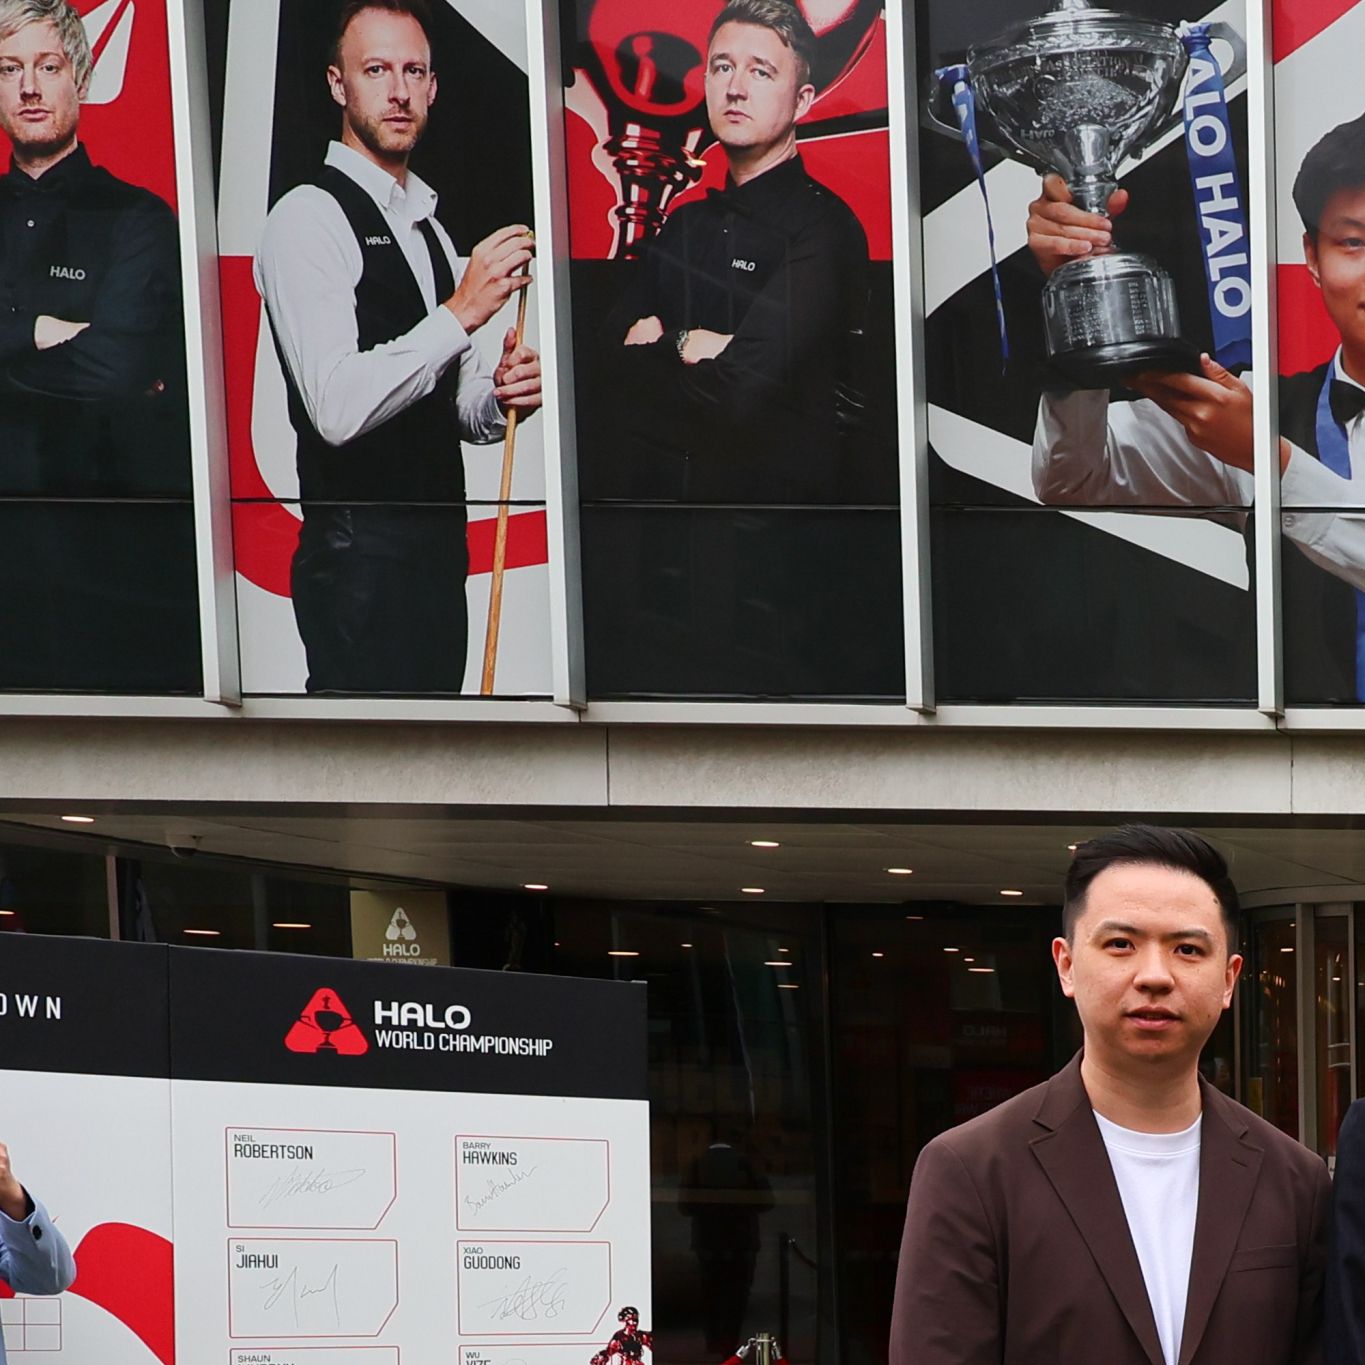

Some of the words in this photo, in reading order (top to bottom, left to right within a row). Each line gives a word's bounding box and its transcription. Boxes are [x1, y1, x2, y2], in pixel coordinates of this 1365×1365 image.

[1184, 57, 1227, 158] ALO
[365, 235, 391, 246] HALO
[1195, 171, 1252, 318] HALO
[731, 258, 756, 272] HALO
[50, 265, 86, 280] HALO
[383, 943, 420, 956] HALO
[374, 1000, 472, 1030] HALO
[375, 1030, 434, 1050] WORLD
[438, 1034, 553, 1056] CHAMPIONSHIP
[234, 1134, 256, 1142] NEIL
[234, 1143, 313, 1160] ROBERTSON
[463, 1142, 491, 1150] BARRY
[463, 1151, 518, 1166] HAWKINS
[463, 1247, 483, 1255] XIAO
[236, 1254, 278, 1268] JIAHUI
[463, 1256, 521, 1270] GUODONG
[238, 1355, 271, 1363] SHAUN
